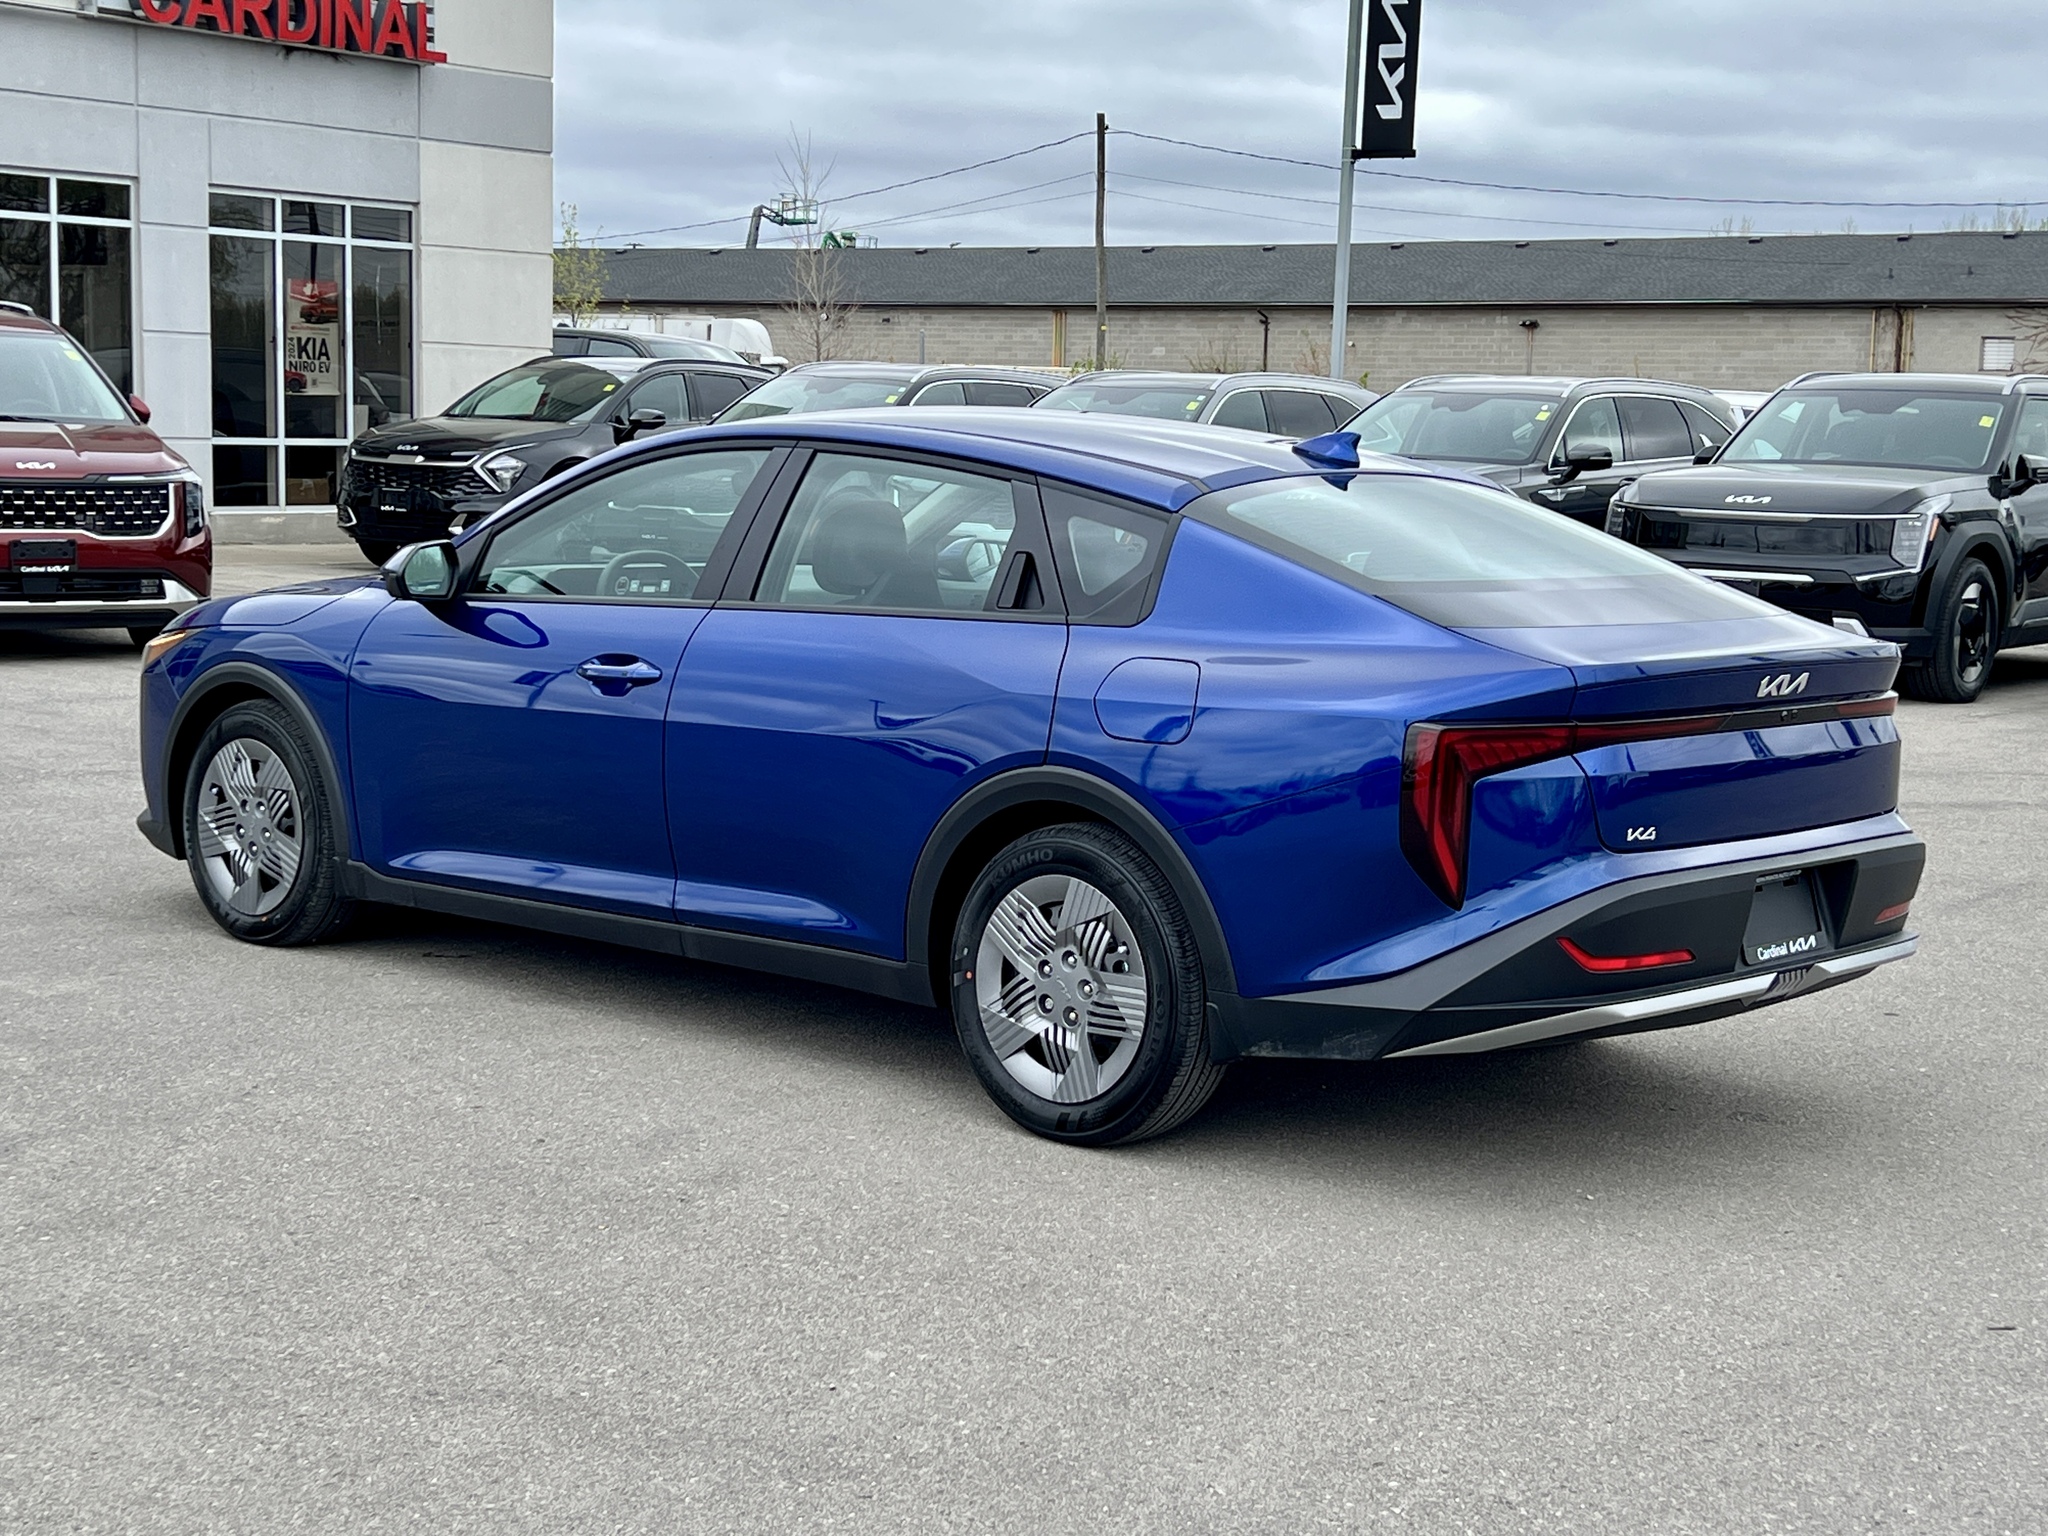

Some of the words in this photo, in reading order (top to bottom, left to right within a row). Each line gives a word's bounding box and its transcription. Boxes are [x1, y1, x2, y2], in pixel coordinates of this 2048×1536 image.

[1375, 0, 1409, 119] KIA
[288, 337, 296, 359] 2024
[296, 337, 330, 360] KIA
[288, 360, 317, 374] NIRO
[318, 362, 331, 373] EV
[1725, 494, 1772, 504] KIA
[1756, 672, 1810, 698] KIA
[1626, 826, 1657, 842] K4
[991, 849, 1054, 888] KUMHO
[1756, 943, 1788, 961] Cardinal
[1788, 934, 1817, 954] KIA
